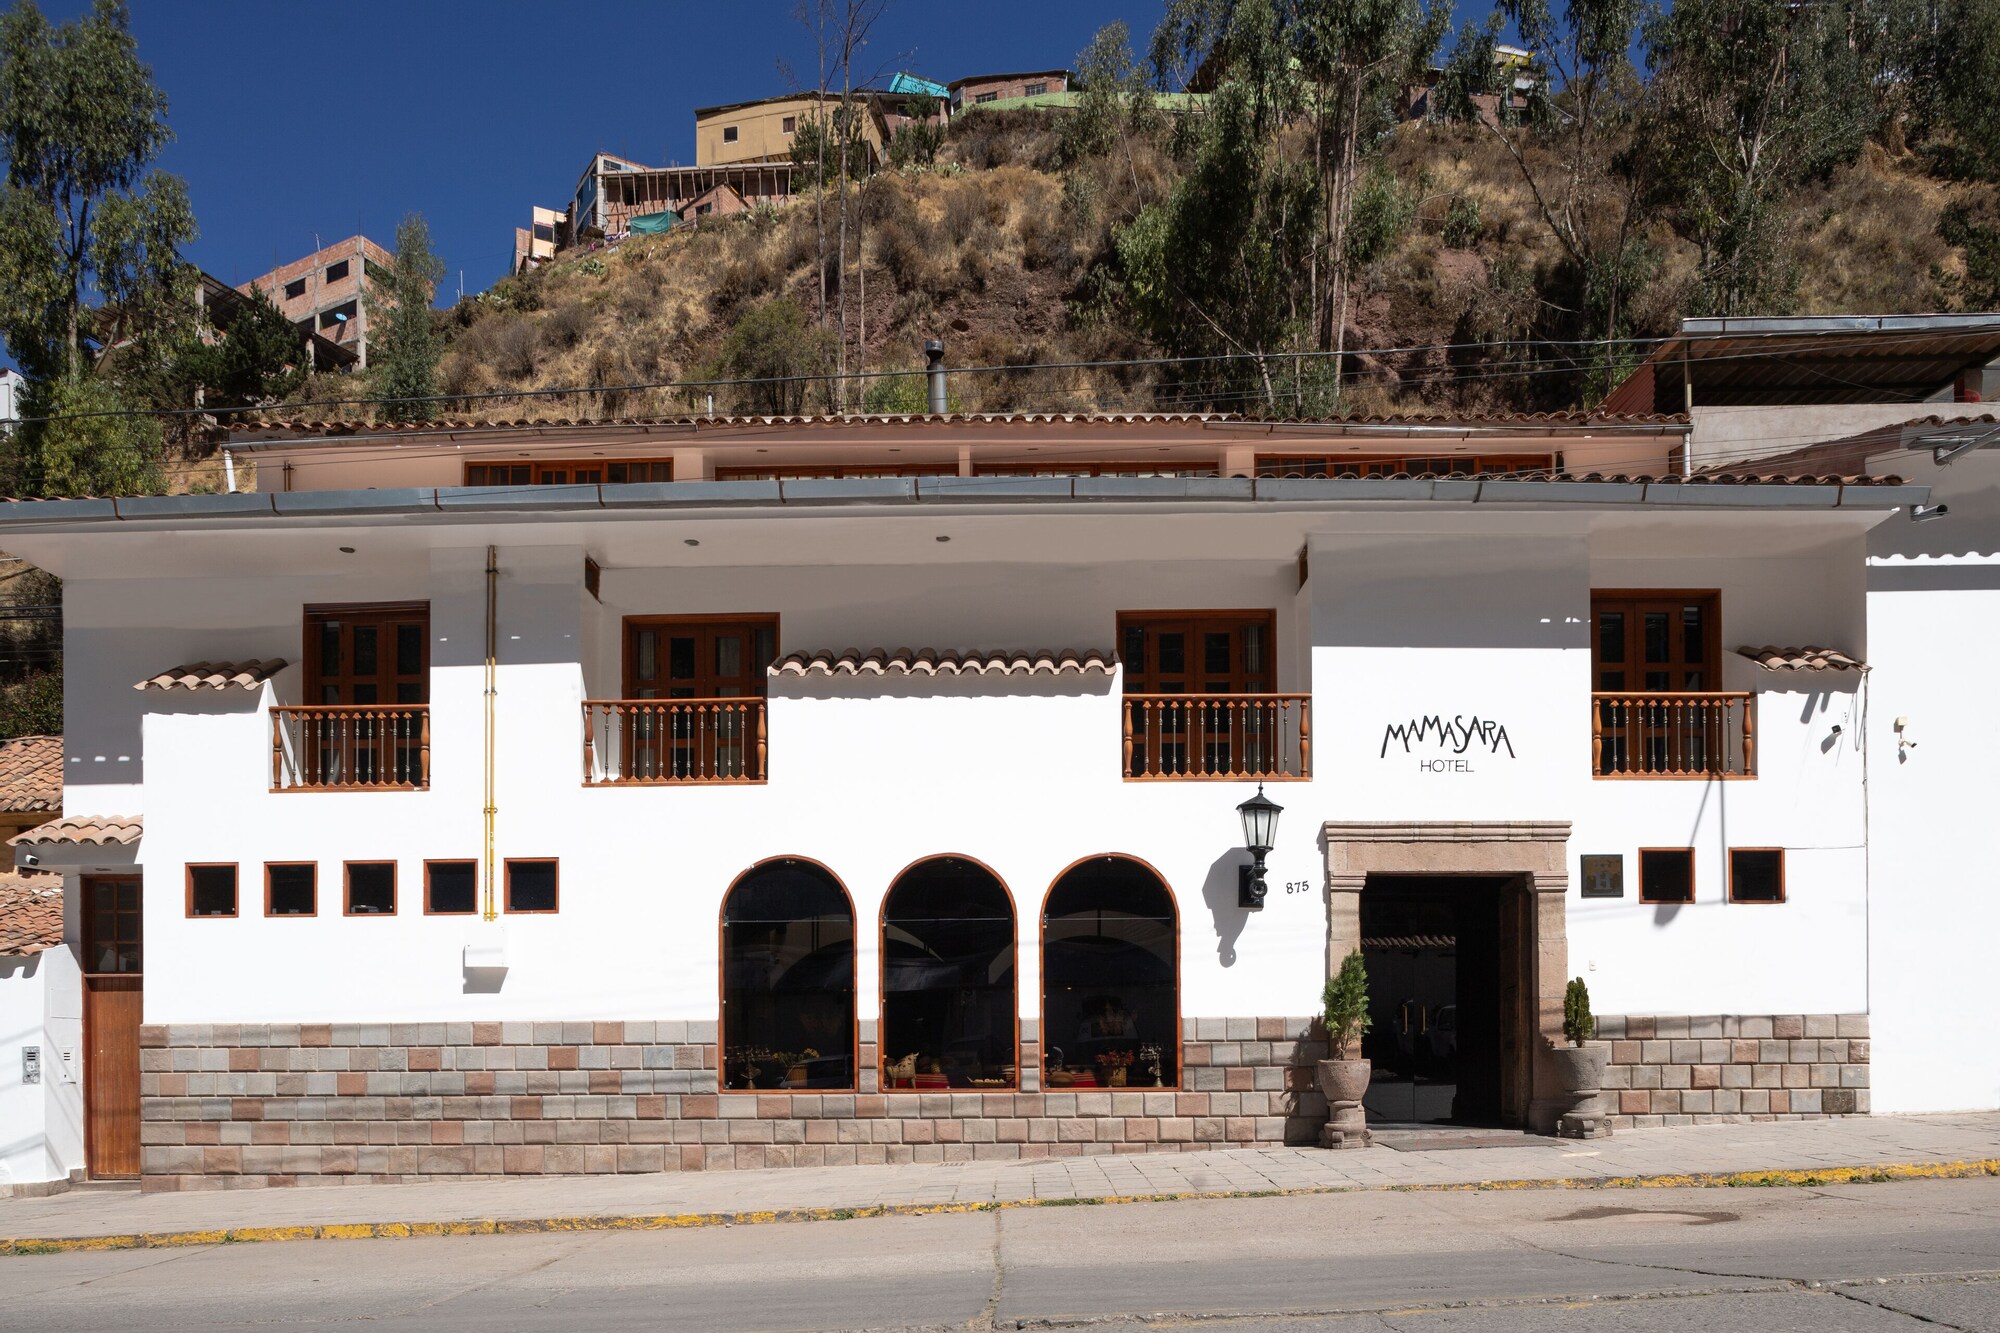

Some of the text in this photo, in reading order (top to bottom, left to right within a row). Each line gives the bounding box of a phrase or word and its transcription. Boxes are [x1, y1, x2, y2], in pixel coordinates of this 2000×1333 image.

[1380, 715, 1516, 759] MAMASARA
[1420, 759, 1475, 773] HOTEL
[1286, 880, 1310, 896] 875
